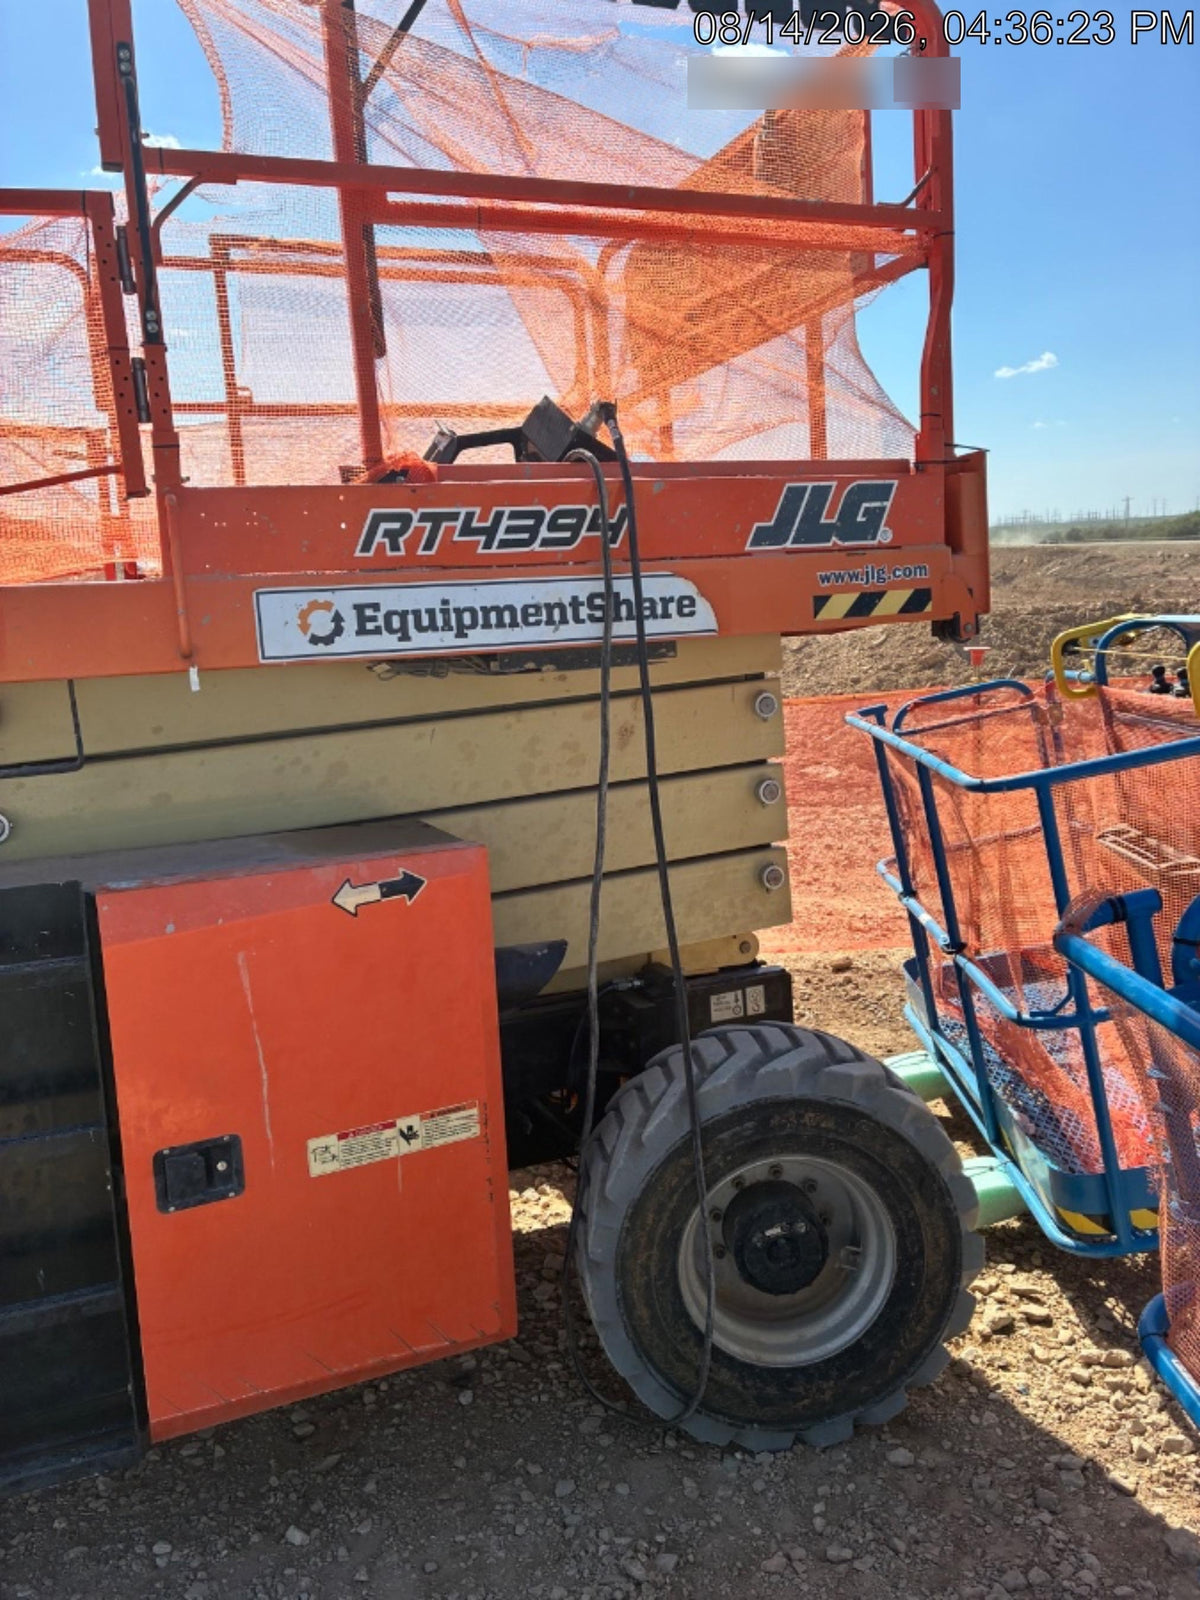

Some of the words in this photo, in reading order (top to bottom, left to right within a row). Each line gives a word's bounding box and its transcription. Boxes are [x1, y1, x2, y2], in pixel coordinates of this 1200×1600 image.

[353, 504, 628, 557] RT4394
[817, 563, 928, 587] www.jlg.com
[352, 591, 696, 642] EquipmentShare
